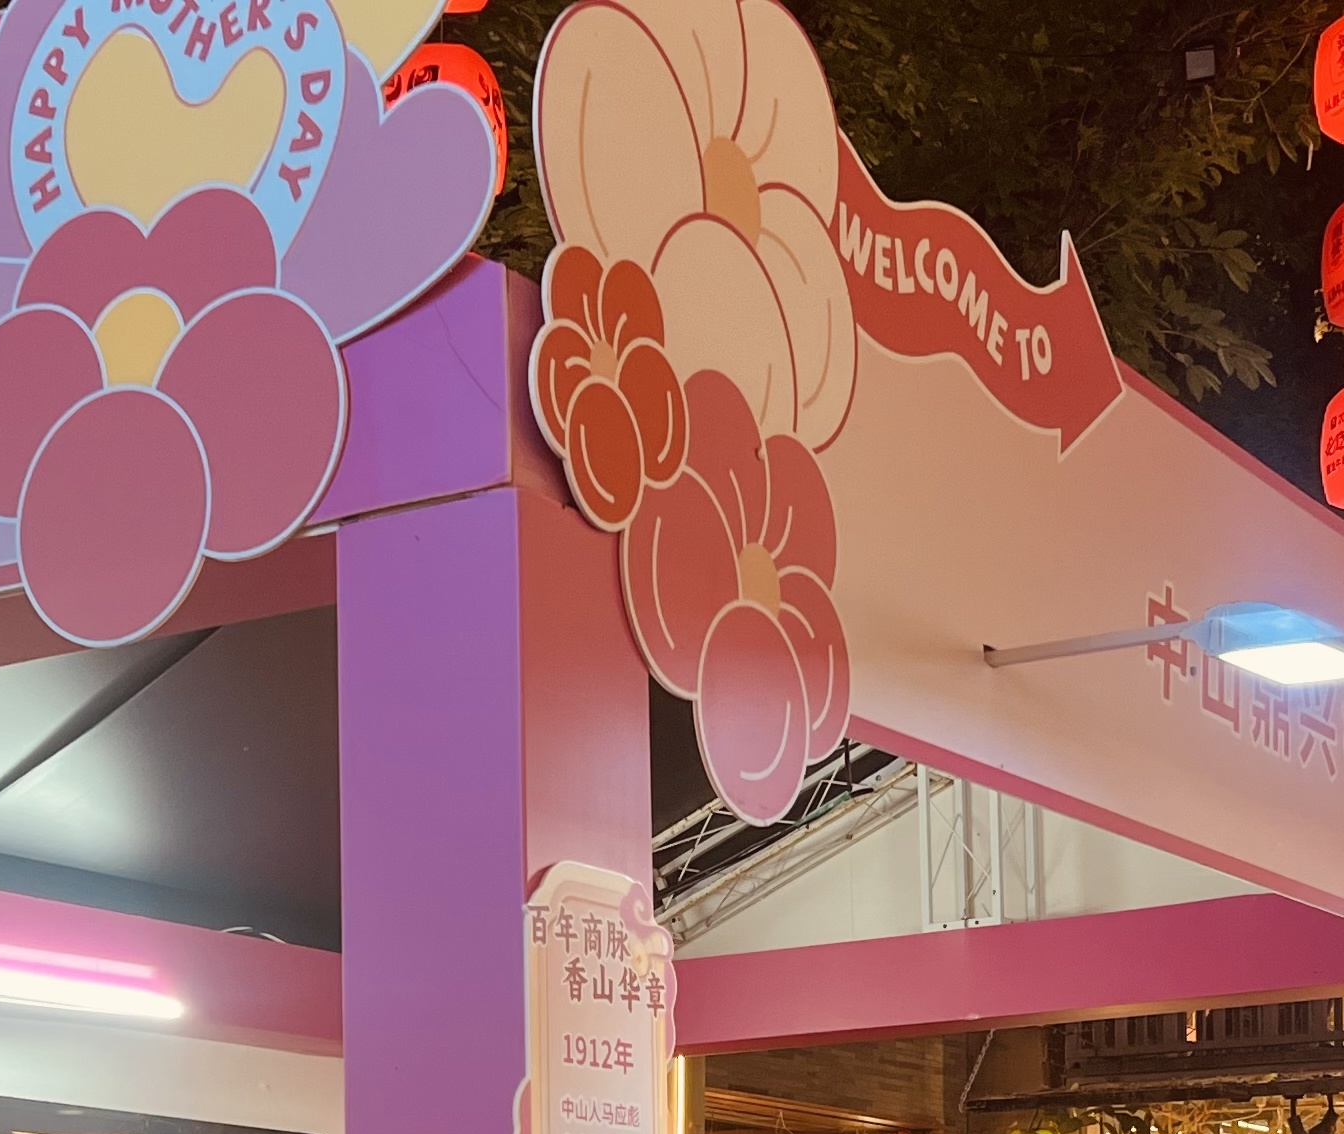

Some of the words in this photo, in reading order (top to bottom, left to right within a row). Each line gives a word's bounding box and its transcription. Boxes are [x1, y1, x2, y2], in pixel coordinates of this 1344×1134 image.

[278, 70, 332, 203] DAY
[838, 201, 1008, 367] WELCOME
[1015, 324, 1053, 381] TO
[527, 904, 632, 962] 百年商脉
[562, 957, 666, 1019] 香山华章
[562, 1034, 634, 1076] 1912年
[561, 1096, 641, 1129] 中山人马应彪
